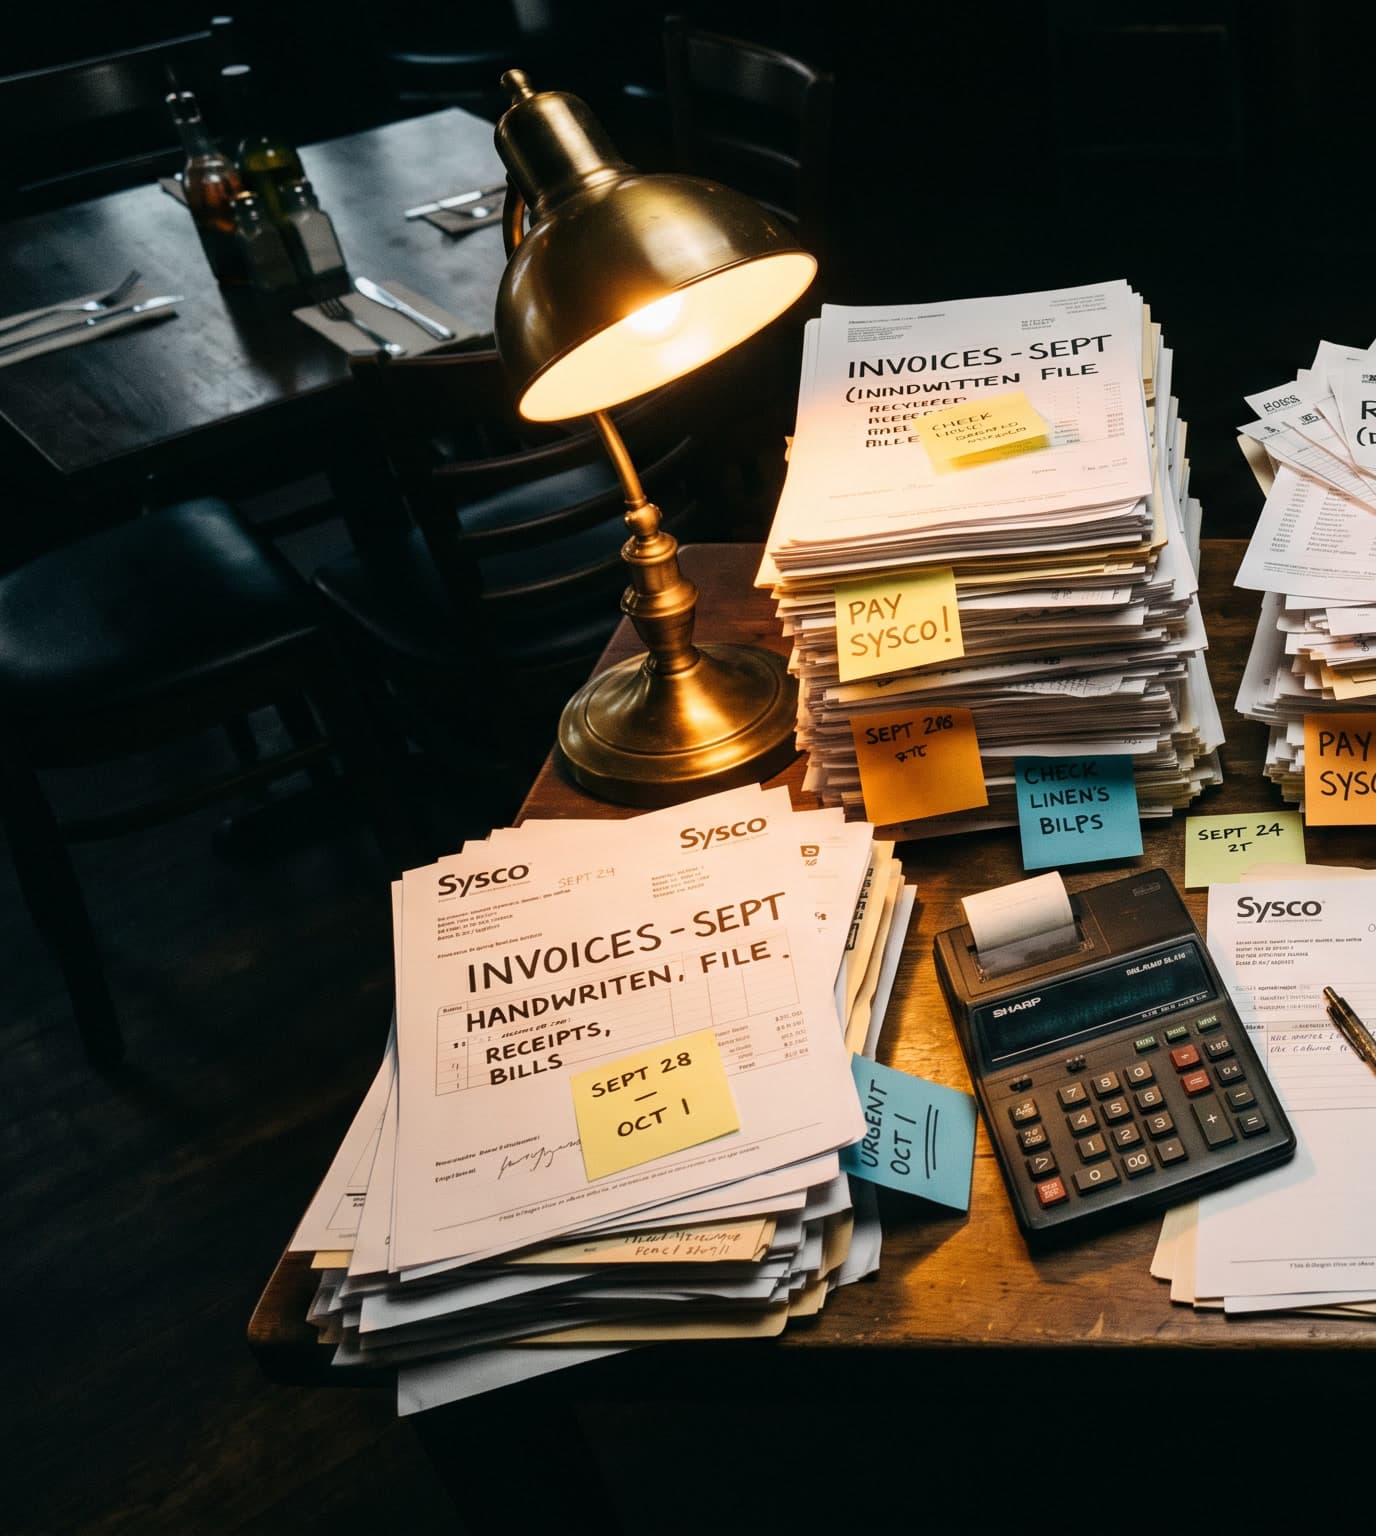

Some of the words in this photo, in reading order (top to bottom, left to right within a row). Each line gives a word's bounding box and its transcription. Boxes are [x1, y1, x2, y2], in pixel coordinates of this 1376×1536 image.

[848, 347, 1003, 379] INVOICES
[1029, 334, 1112, 360] SEPT
[1041, 363, 1098, 380] FILE
[848, 594, 902, 625] PAY
[850, 605, 952, 657] SYSCO!
[865, 721, 914, 745] SEPT
[1318, 731, 1372, 760] PAY
[1023, 761, 1098, 785] CHECK
[1030, 786, 1110, 809] LINEN'S
[680, 816, 768, 851] Sysco
[1198, 826, 1248, 841] SEPT
[1256, 822, 1284, 837] 24
[438, 864, 530, 898] Sysco
[558, 872, 592, 889] SEPT
[596, 866, 616, 880] 24
[1237, 897, 1323, 922] Sysco
[467, 922, 662, 993] INVOICES
[693, 891, 786, 937] SEPT
[992, 997, 1041, 1019] SHARP
[486, 1020, 611, 1064] RECEIPTS,
[490, 1053, 563, 1085] BILLS
[591, 1067, 649, 1098] SEPT
[661, 1052, 692, 1074] 28
[1067, 1088, 1077, 1098] 7
[1100, 1077, 1112, 1088] 8
[1110, 1103, 1122, 1114] 5
[1144, 1091, 1156, 1102] 6
[617, 1106, 667, 1137] OCT
[681, 1098, 691, 1115] 1
[860, 1079, 888, 1167] URGENT
[893, 1113, 917, 1125] 1
[1077, 1114, 1088, 1124] 4
[1154, 1117, 1166, 1128] 3
[1087, 1141, 1095, 1151] 1
[1120, 1129, 1132, 1141] 2
[890, 1135, 913, 1176] OCT
[1127, 1153, 1147, 1168] 00
